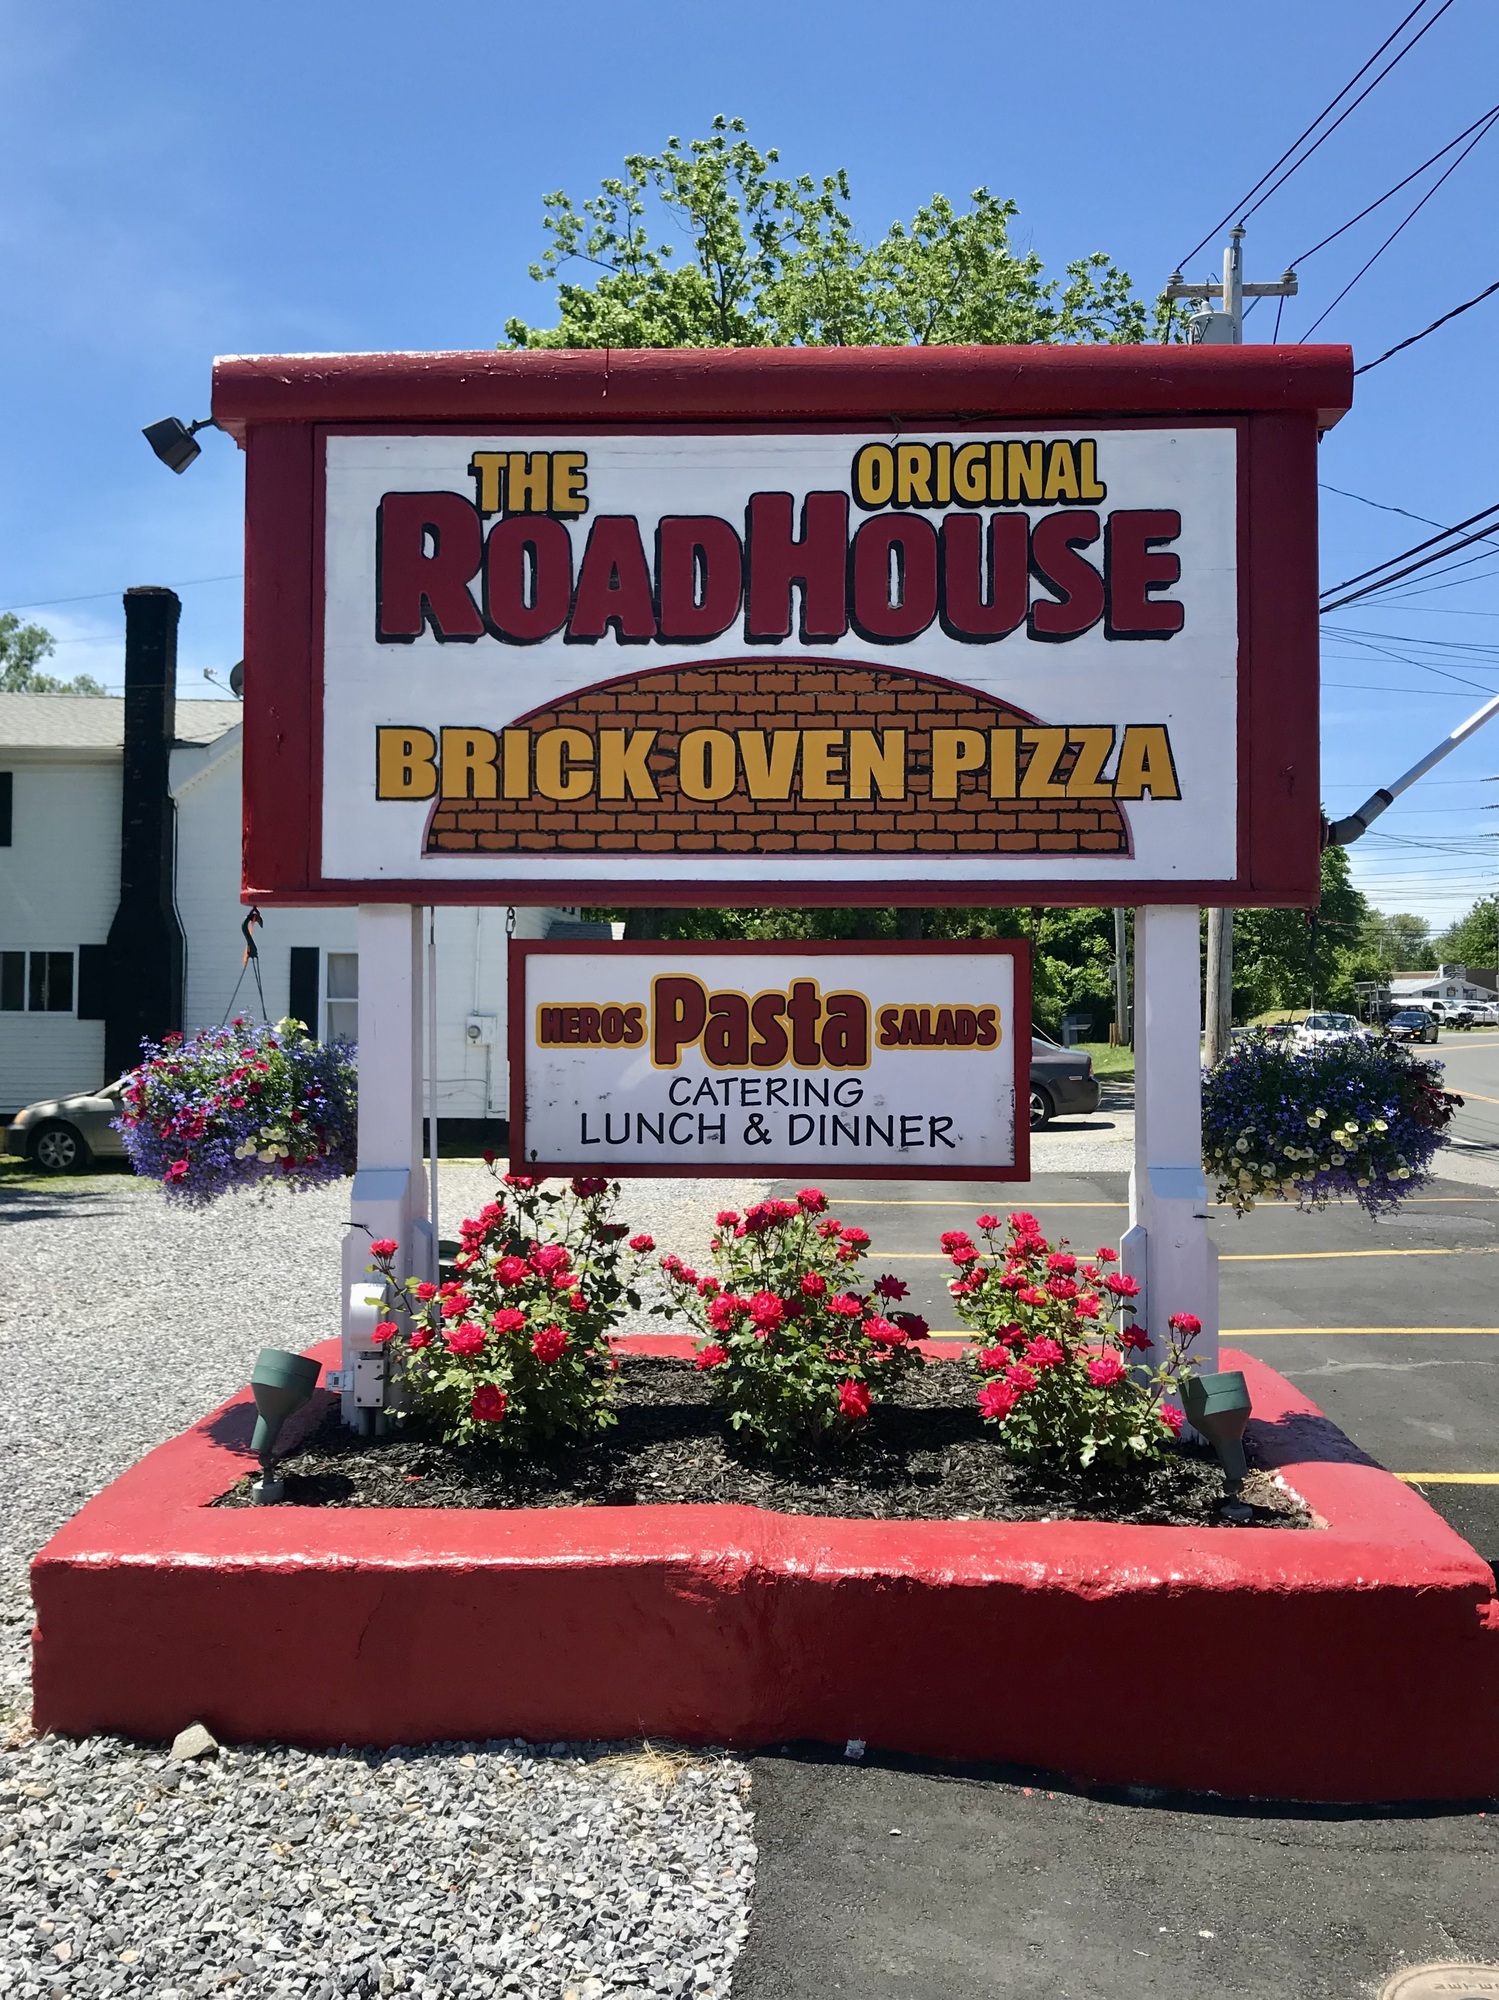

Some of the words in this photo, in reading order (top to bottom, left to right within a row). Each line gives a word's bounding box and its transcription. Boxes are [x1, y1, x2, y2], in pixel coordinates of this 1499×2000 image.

[472, 450, 589, 520] THE
[851, 439, 1107, 509] ORIGINAL
[374, 491, 1185, 644] ROADHOUSE
[374, 725, 661, 801] BRICK
[677, 727, 906, 800] OVEN
[926, 725, 1182, 801] PIZZA
[540, 1006, 643, 1045] HEROS
[653, 976, 869, 1067] Pasta
[879, 1008, 997, 1046] SALADS
[580, 1112, 727, 1145] LUNCH
[743, 1113, 772, 1146] &
[788, 1113, 956, 1149] DINNER
[669, 1076, 864, 1107] CATERING
